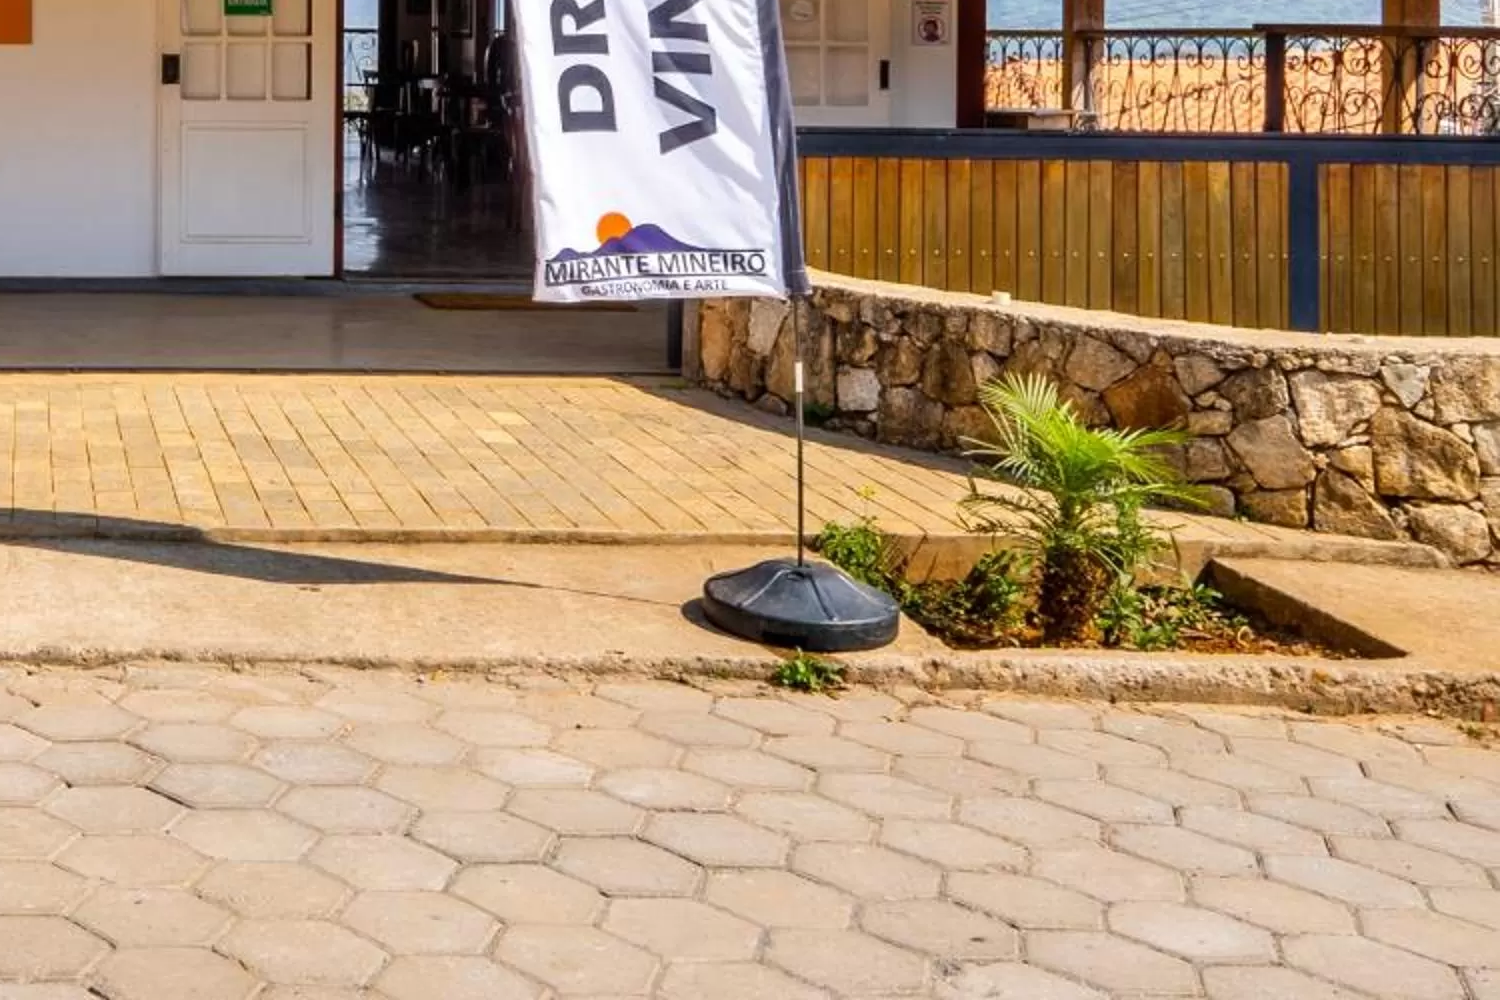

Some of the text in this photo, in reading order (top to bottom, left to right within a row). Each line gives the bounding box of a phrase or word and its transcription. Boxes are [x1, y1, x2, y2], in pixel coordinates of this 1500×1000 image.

[545, 253, 765, 281] MIRANTE MINEIRO
[581, 279, 679, 296] GASTRONOMIA
[683, 280, 691, 291] E
